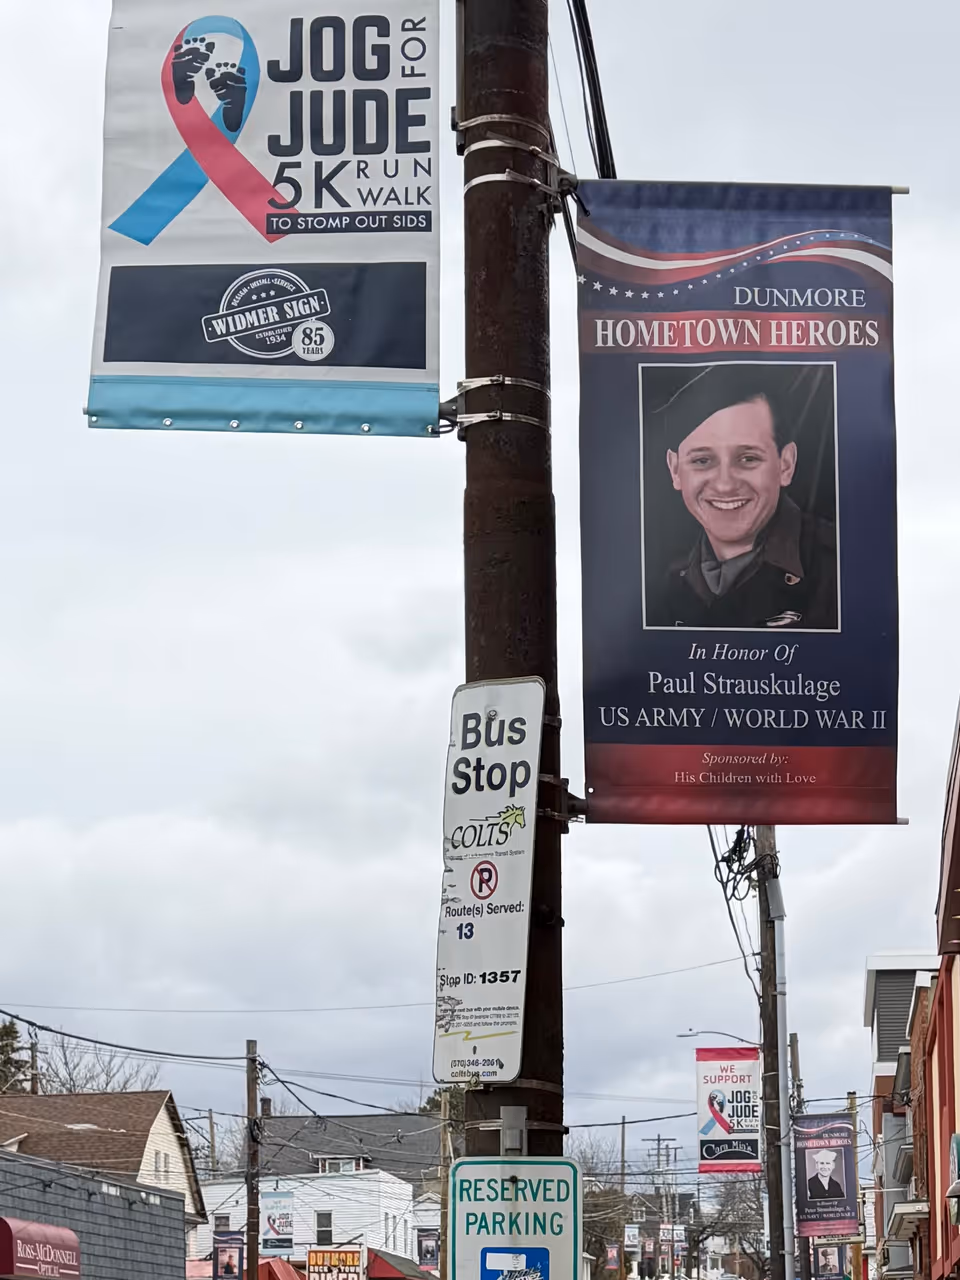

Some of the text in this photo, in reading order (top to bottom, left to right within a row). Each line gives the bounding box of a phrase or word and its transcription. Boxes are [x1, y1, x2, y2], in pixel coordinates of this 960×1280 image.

[267, 15, 390, 82] JOG
[400, 16, 427, 78] FOR
[267, 87, 431, 157] JUDE
[356, 158, 432, 179] RUN
[267, 160, 352, 209] 5K
[357, 185, 432, 206] WALK
[271, 215, 427, 230] TO STOMP OUT SIDS
[733, 286, 866, 307] DUNMORE
[211, 295, 320, 335] WIDMER SIGN
[265, 334, 286, 344] 1934
[301, 327, 325, 346] 85
[595, 318, 879, 348] HOMETOWN HEROES
[302, 346, 323, 355] YEARS
[688, 643, 799, 665] In Honor Of
[648, 671, 841, 701] Paul Strauskulage
[599, 707, 630, 727] US
[635, 707, 705, 727] ARMY
[723, 708, 809, 729] WORLD
[815, 710, 866, 729] WAR
[871, 710, 887, 730] II
[461, 712, 526, 751] Bus
[701, 752, 789, 766] Sponsored by:
[451, 756, 531, 798] Stop
[674, 771, 817, 784] His Children with Love
[451, 821, 510, 850] COLTS
[445, 900, 524, 918] Route(s) Served:
[456, 922, 474, 940] 13
[440, 969, 521, 987] Stop ID: 1357
[703, 1074, 752, 1084] SUPPORT
[719, 1064, 736, 1074] WE
[727, 1090, 751, 1104] JOG
[728, 1105, 759, 1118] JUDE
[729, 1118, 744, 1129] 5K
[459, 1178, 570, 1202] RESERVED
[465, 1212, 563, 1236] PARKING
[37, 1261, 60, 1277] OPTICAL
[310, 1252, 360, 1265] DUNMORE
